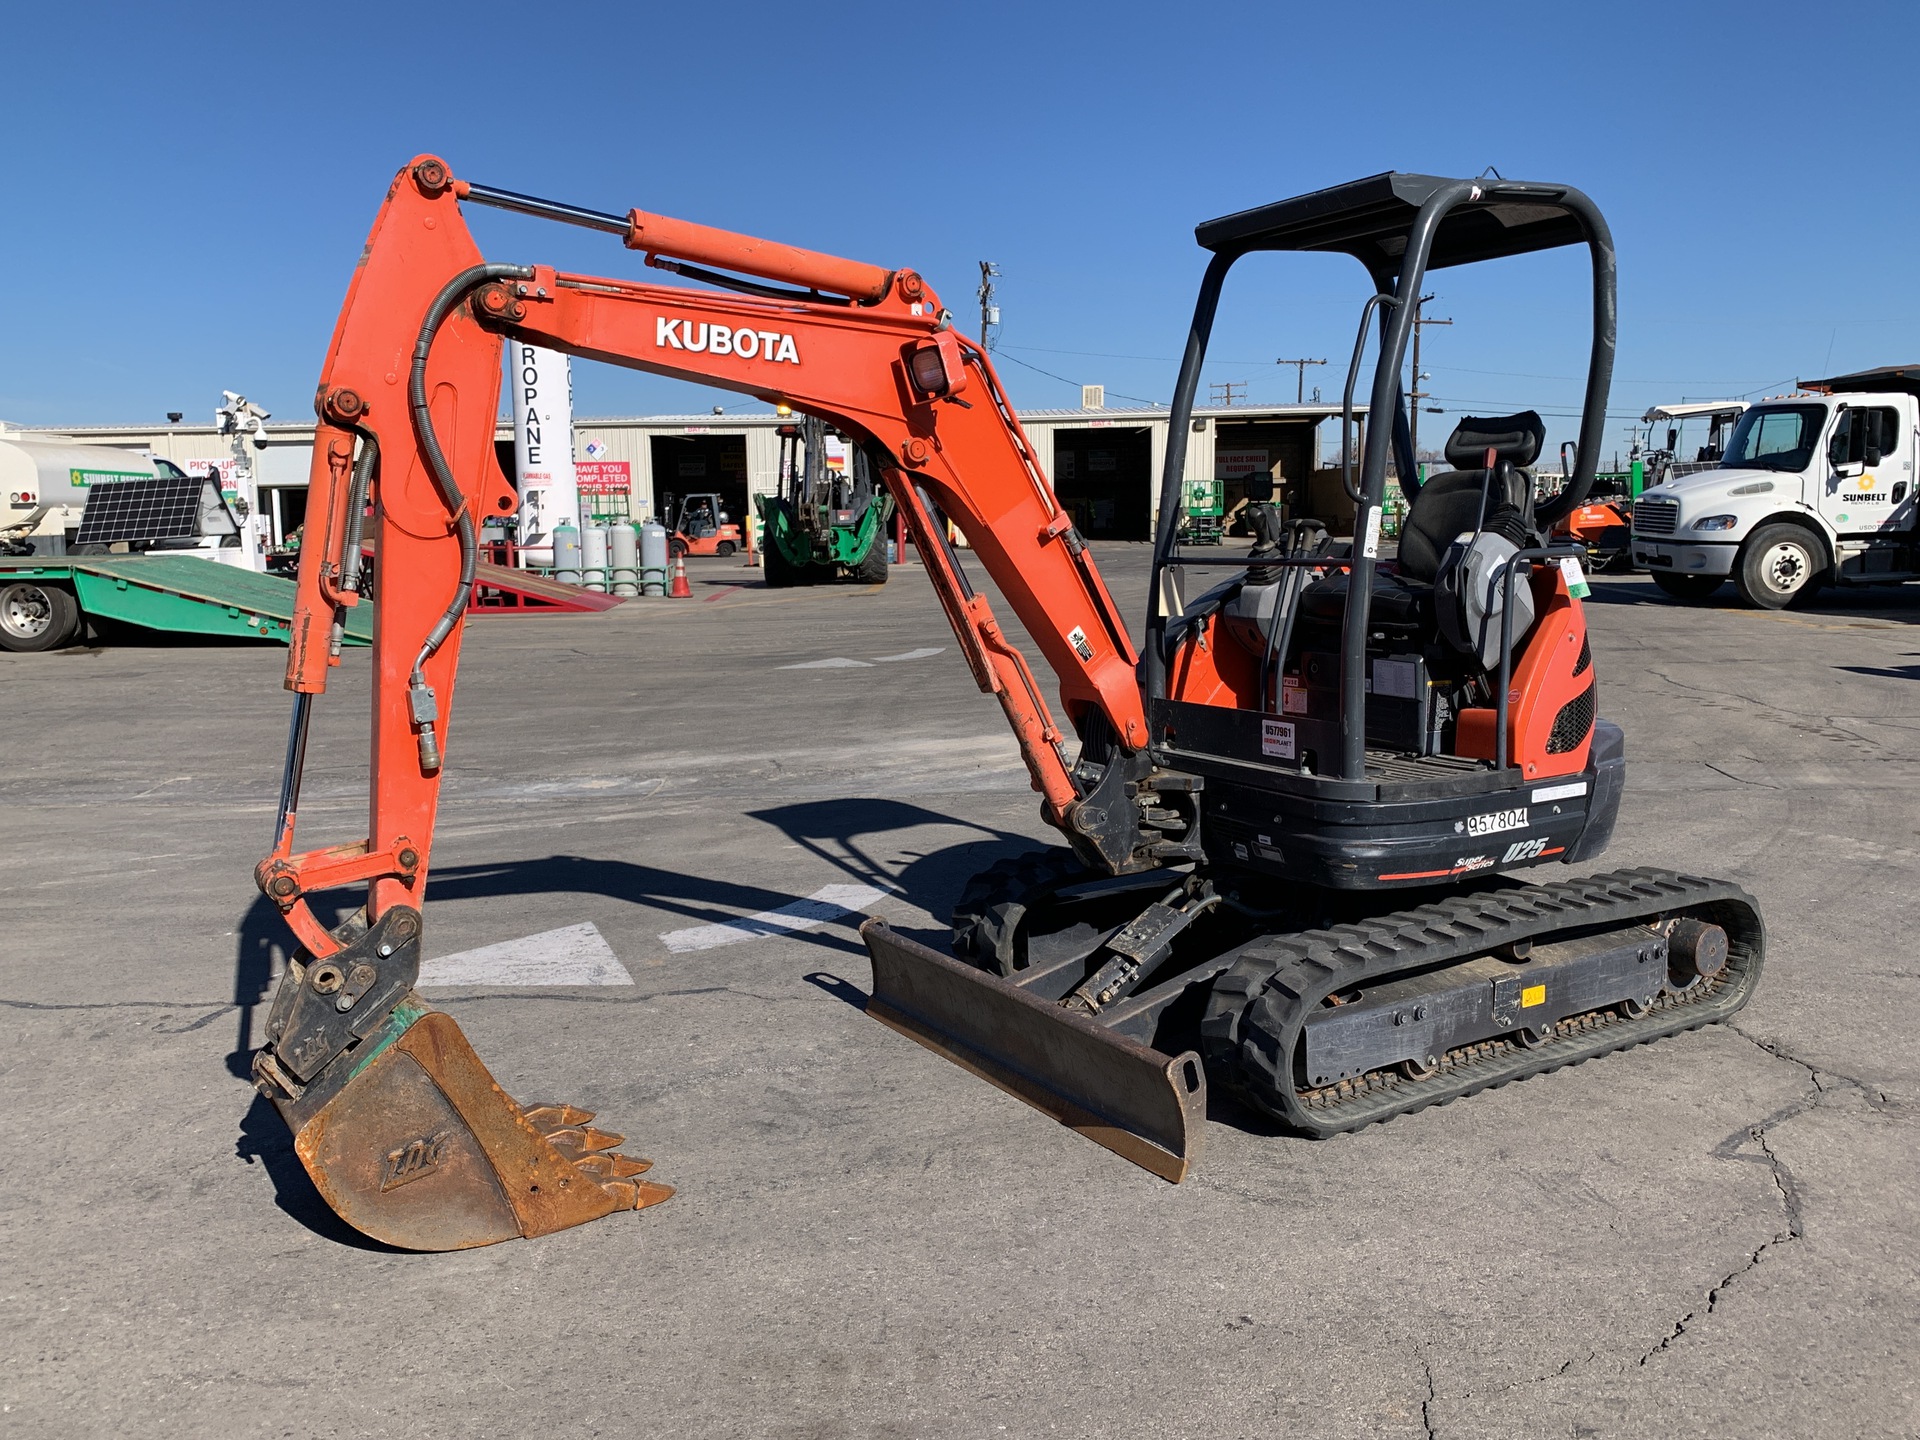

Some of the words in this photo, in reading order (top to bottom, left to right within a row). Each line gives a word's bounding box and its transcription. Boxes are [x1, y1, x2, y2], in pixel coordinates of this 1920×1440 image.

[656, 316, 800, 364] KUBOTA
[522, 345, 542, 465] ROPANE
[1245, 455, 1266, 463] SHIELD
[575, 465, 600, 473] HAVE
[576, 474, 628, 482] OMPLETED
[1842, 493, 1887, 502] SUNBELT
[1284, 678, 1298, 686] FUSE
[1265, 725, 1291, 738] U577961
[1469, 809, 1526, 834] 957804
[1502, 837, 1549, 863] U25
[1455, 855, 1486, 867] Super
